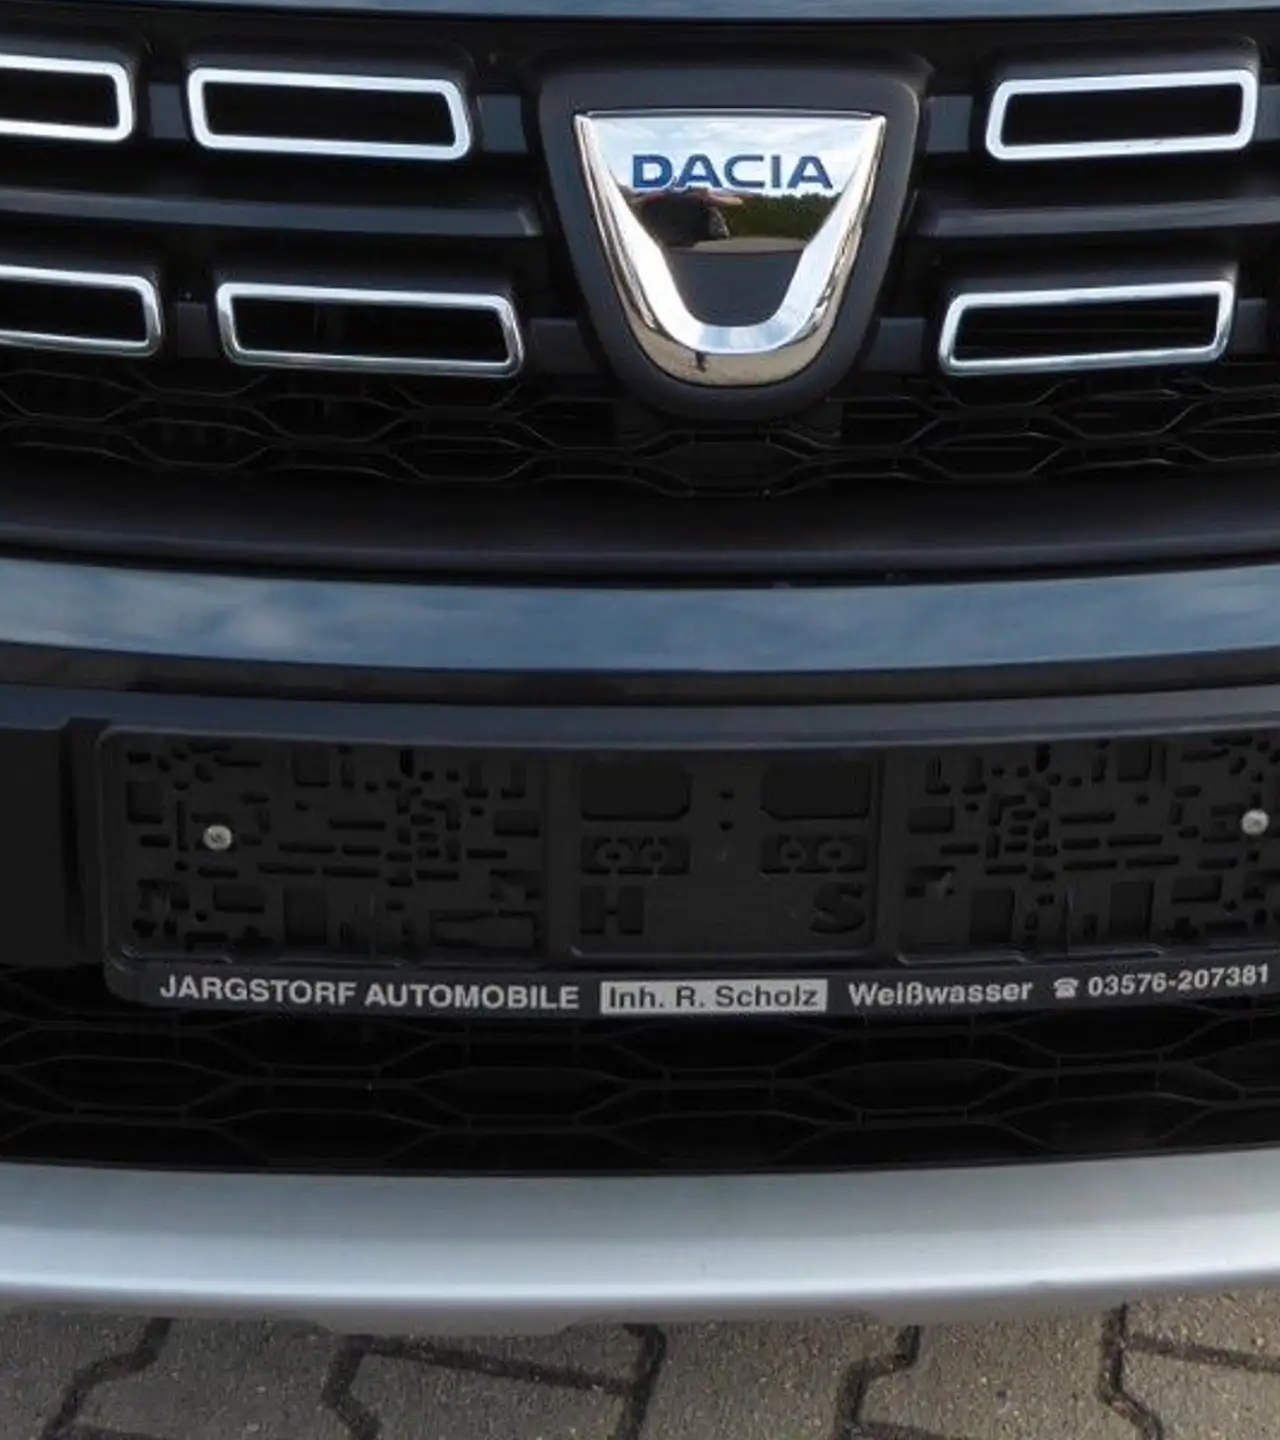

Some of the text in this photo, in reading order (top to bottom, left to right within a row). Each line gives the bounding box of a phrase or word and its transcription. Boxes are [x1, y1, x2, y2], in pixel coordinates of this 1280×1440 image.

[632, 154, 833, 190] DACIA
[159, 963, 1269, 1010] JARGSTORF AUTOMOBILE Inh. R. Scholz Weißwasser 03576-207381
